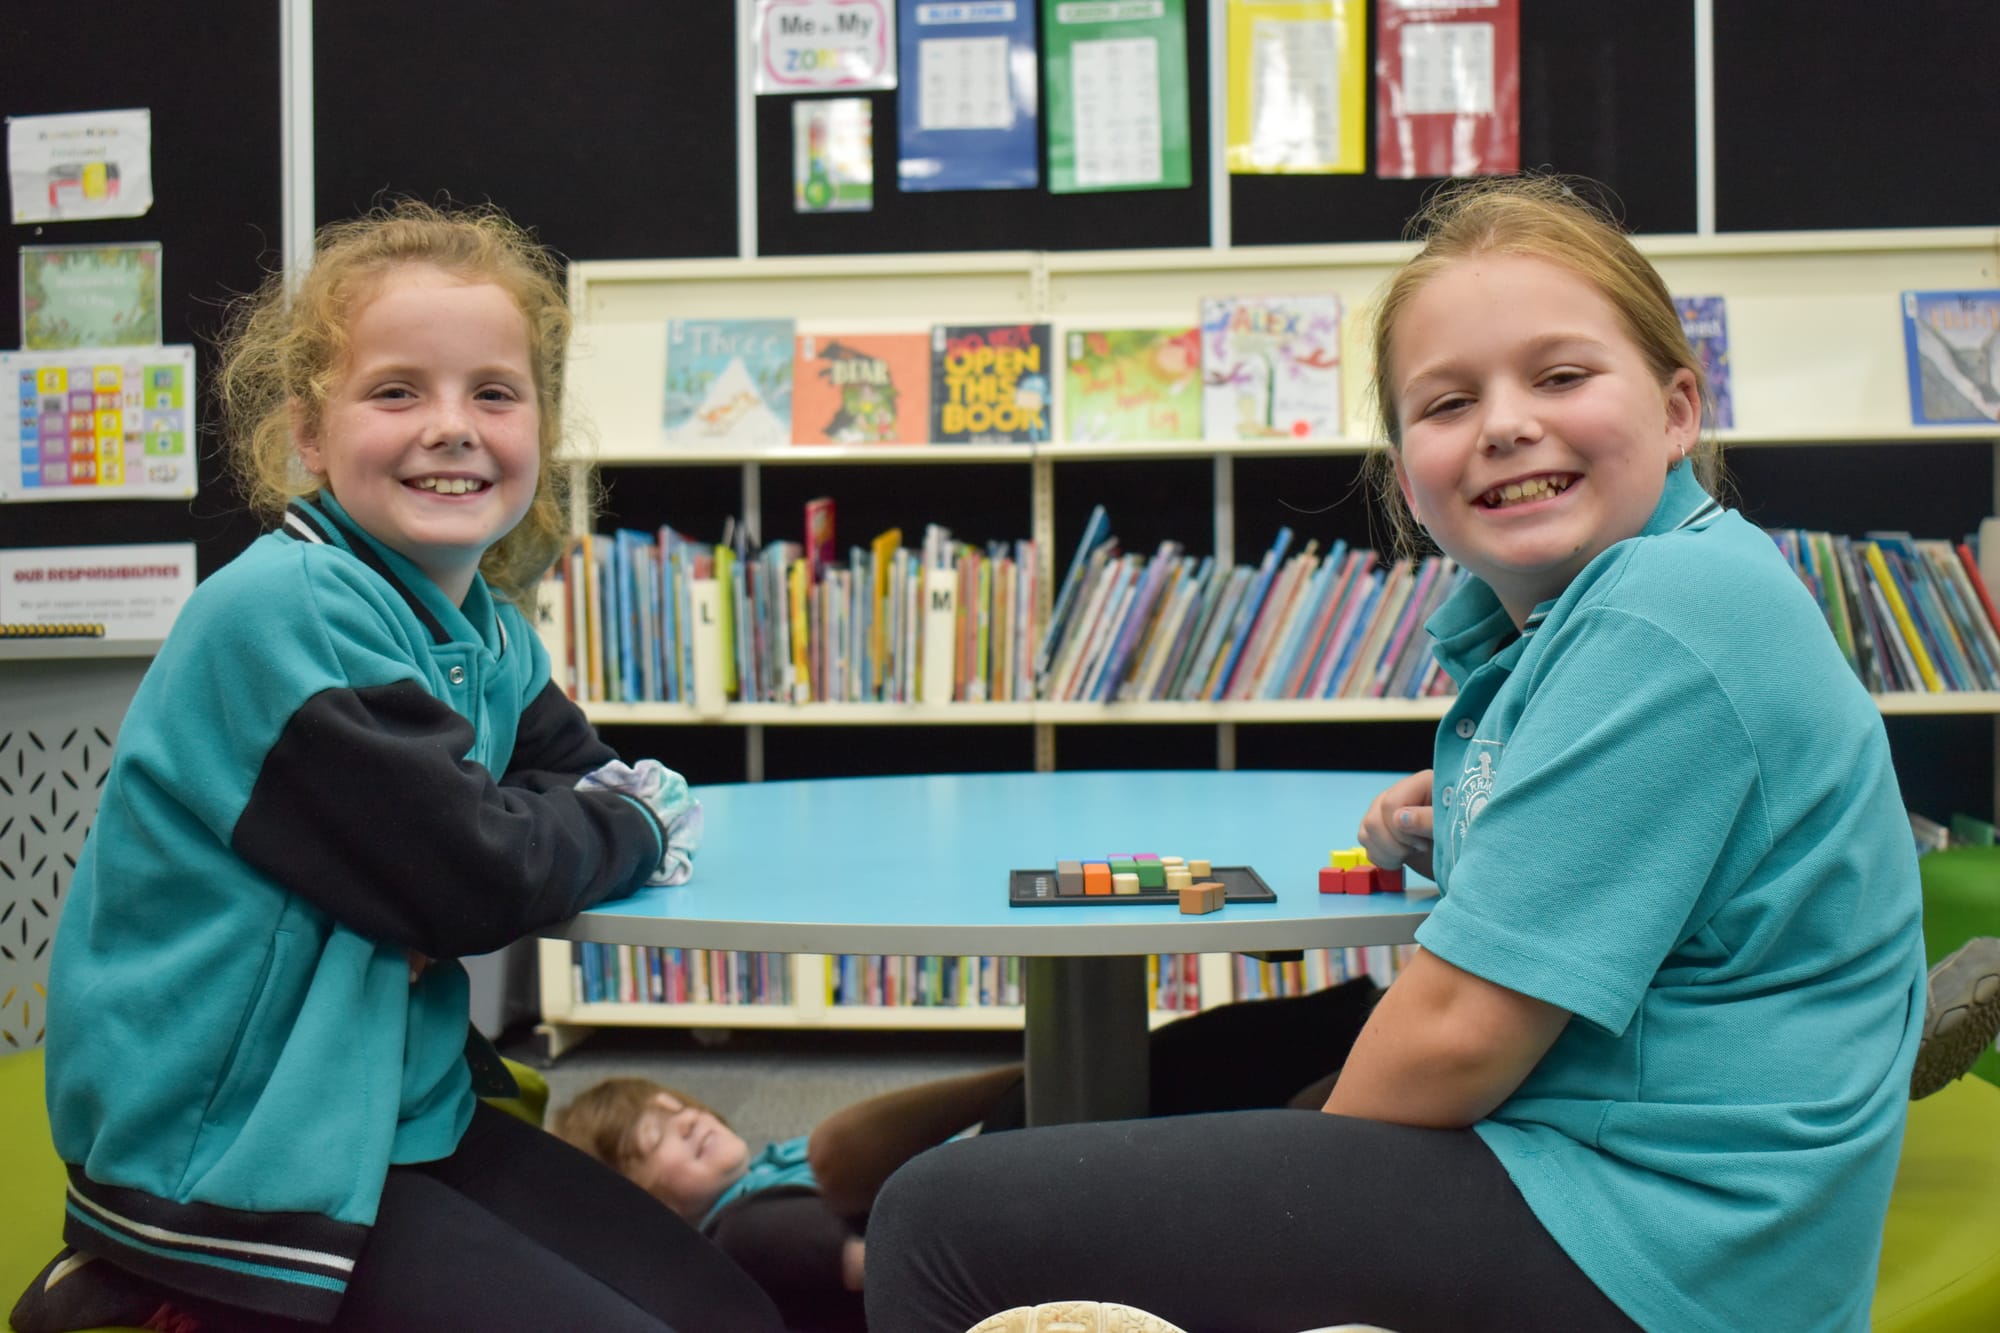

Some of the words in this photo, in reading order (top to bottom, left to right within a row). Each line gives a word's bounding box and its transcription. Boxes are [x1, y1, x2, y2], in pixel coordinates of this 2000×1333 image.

[781, 14, 815, 34] Me
[838, 11, 872, 37] My
[944, 344, 1041, 377] OPEN
[944, 373, 1017, 407] THIS
[941, 402, 1044, 435] BOOK
[14, 567, 44, 583] OUR
[48, 563, 180, 583] RESPONSIBILITIES
[700, 601, 714, 625] L
[931, 590, 952, 611] M
[538, 603, 553, 625] K
